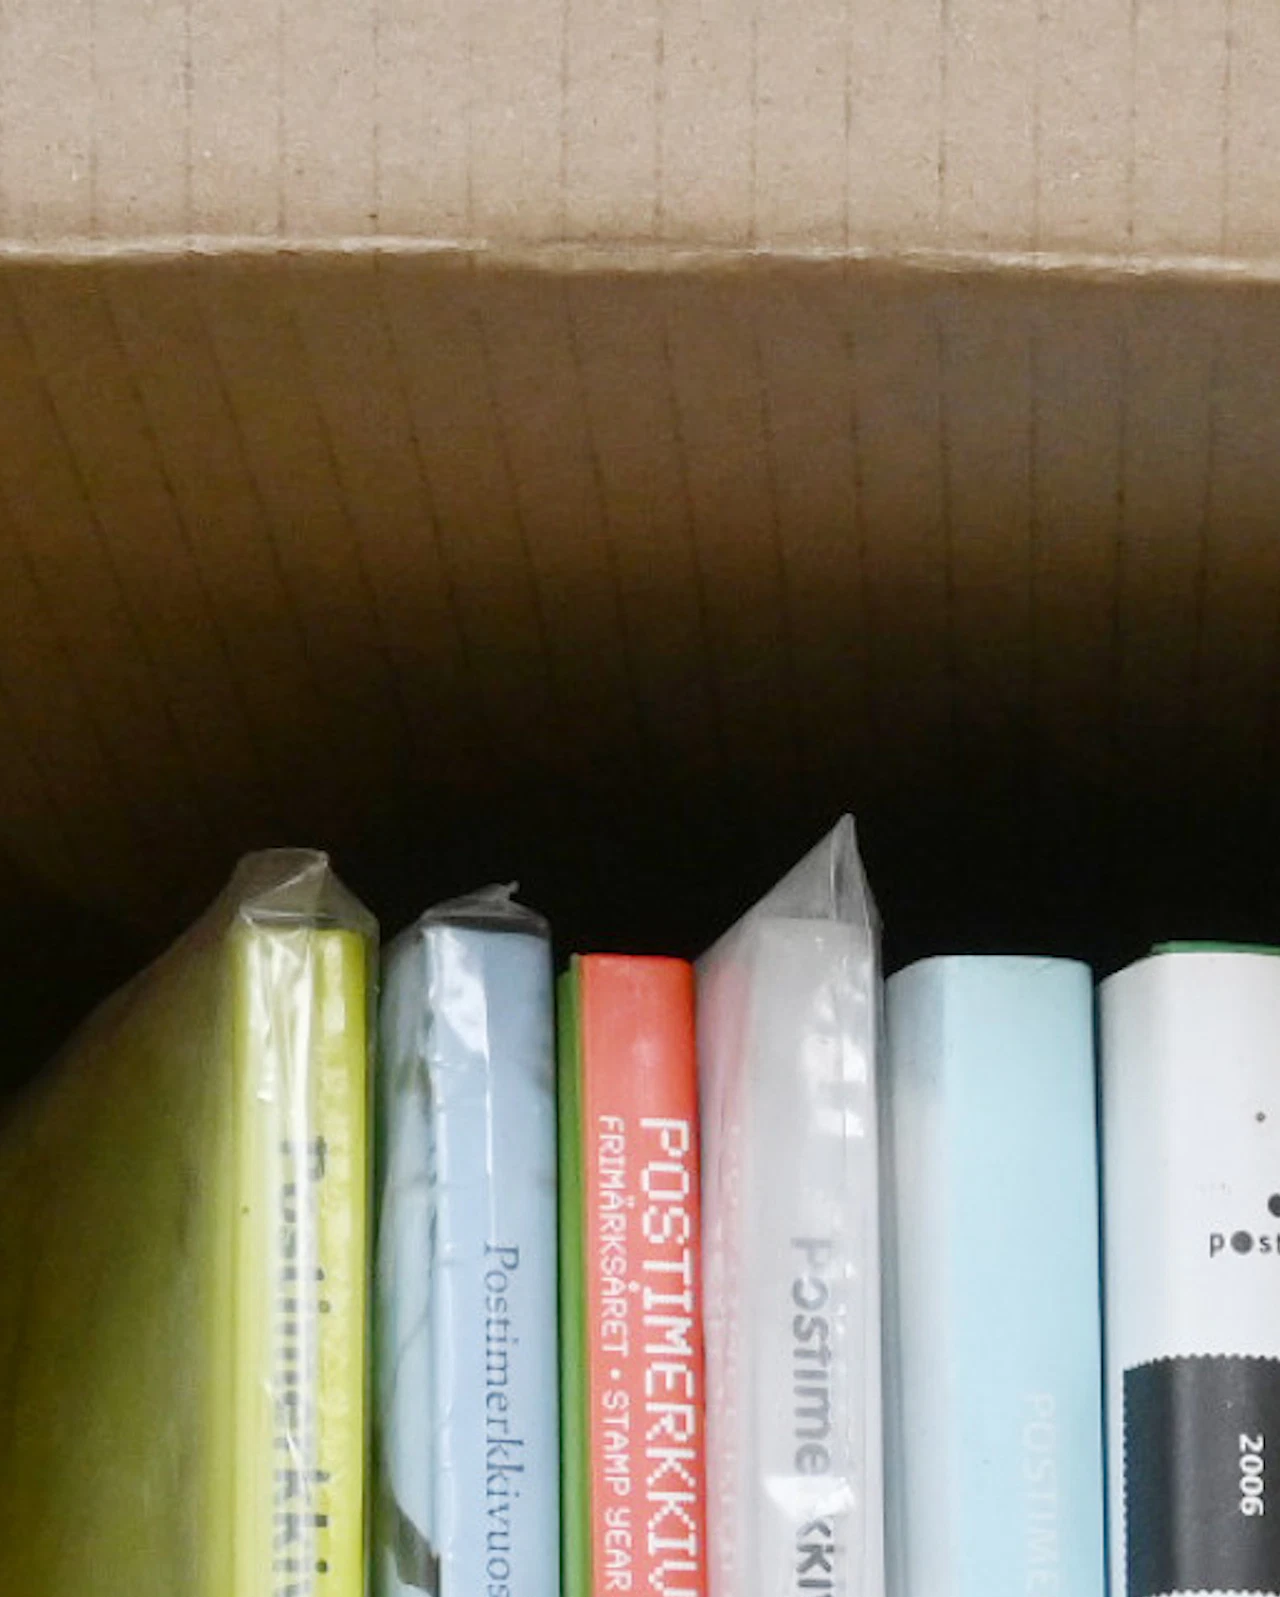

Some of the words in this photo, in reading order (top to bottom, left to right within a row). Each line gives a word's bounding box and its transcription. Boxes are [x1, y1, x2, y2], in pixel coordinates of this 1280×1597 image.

[598, 1116, 640, 1355] FRIMÄRKSÅRET
[603, 1390, 631, 1497] STAMP
[1239, 1434, 1265, 1516] 2006
[604, 1507, 633, 1591] YEAR
